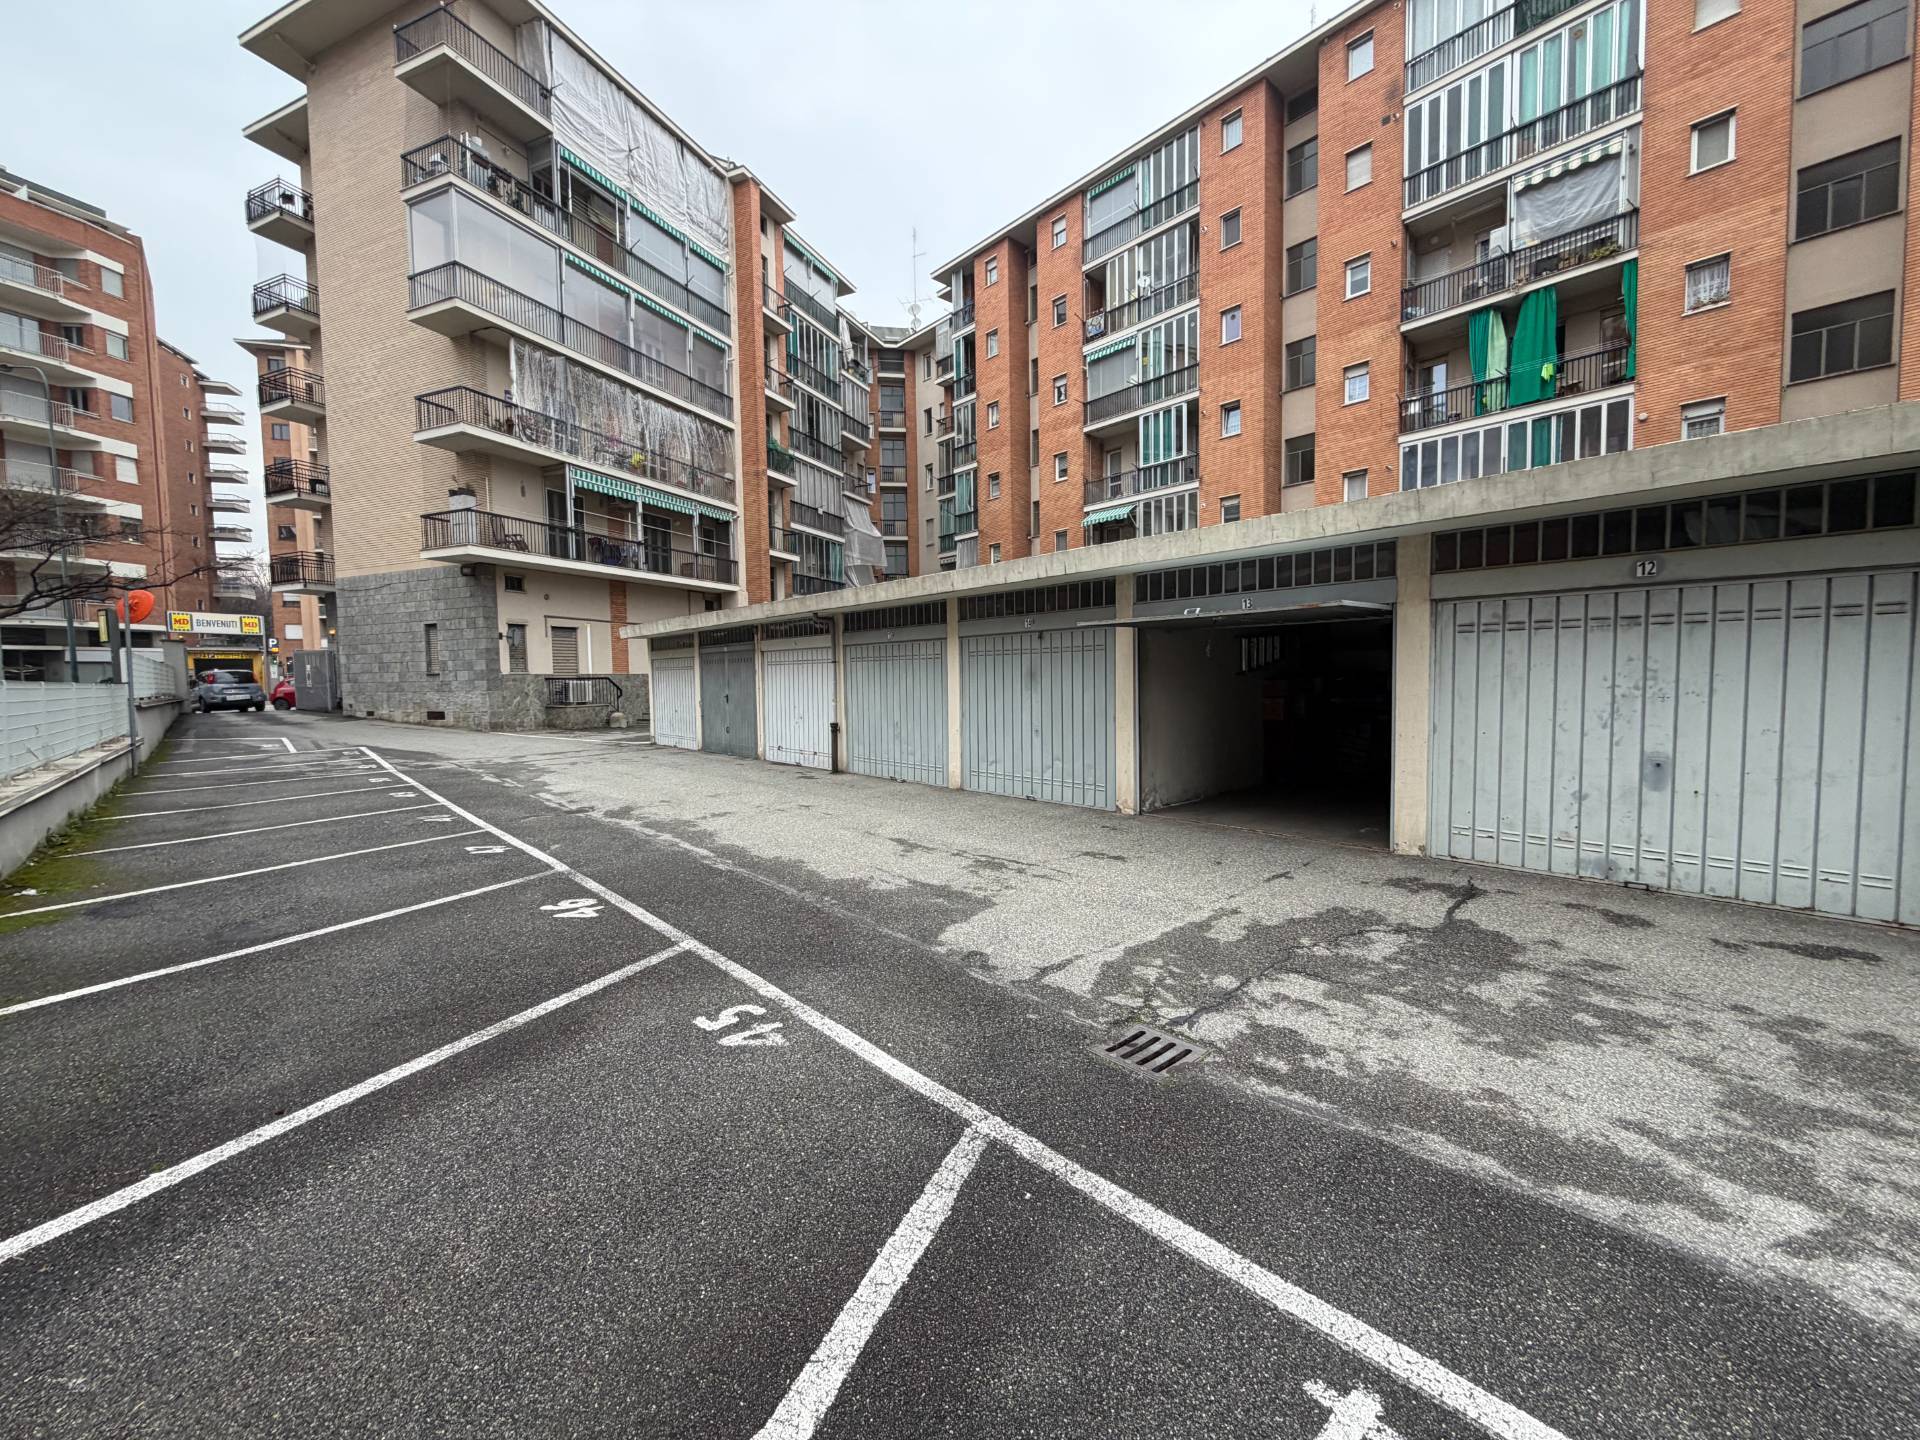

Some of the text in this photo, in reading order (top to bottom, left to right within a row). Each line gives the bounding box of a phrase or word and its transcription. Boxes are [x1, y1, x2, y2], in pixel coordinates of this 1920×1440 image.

[1638, 561, 1656, 575] 12
[1242, 598, 1253, 609] 13
[173, 617, 258, 629] MD BENVENUTI MD
[539, 898, 605, 918] 46
[693, 1004, 789, 1047] 45
